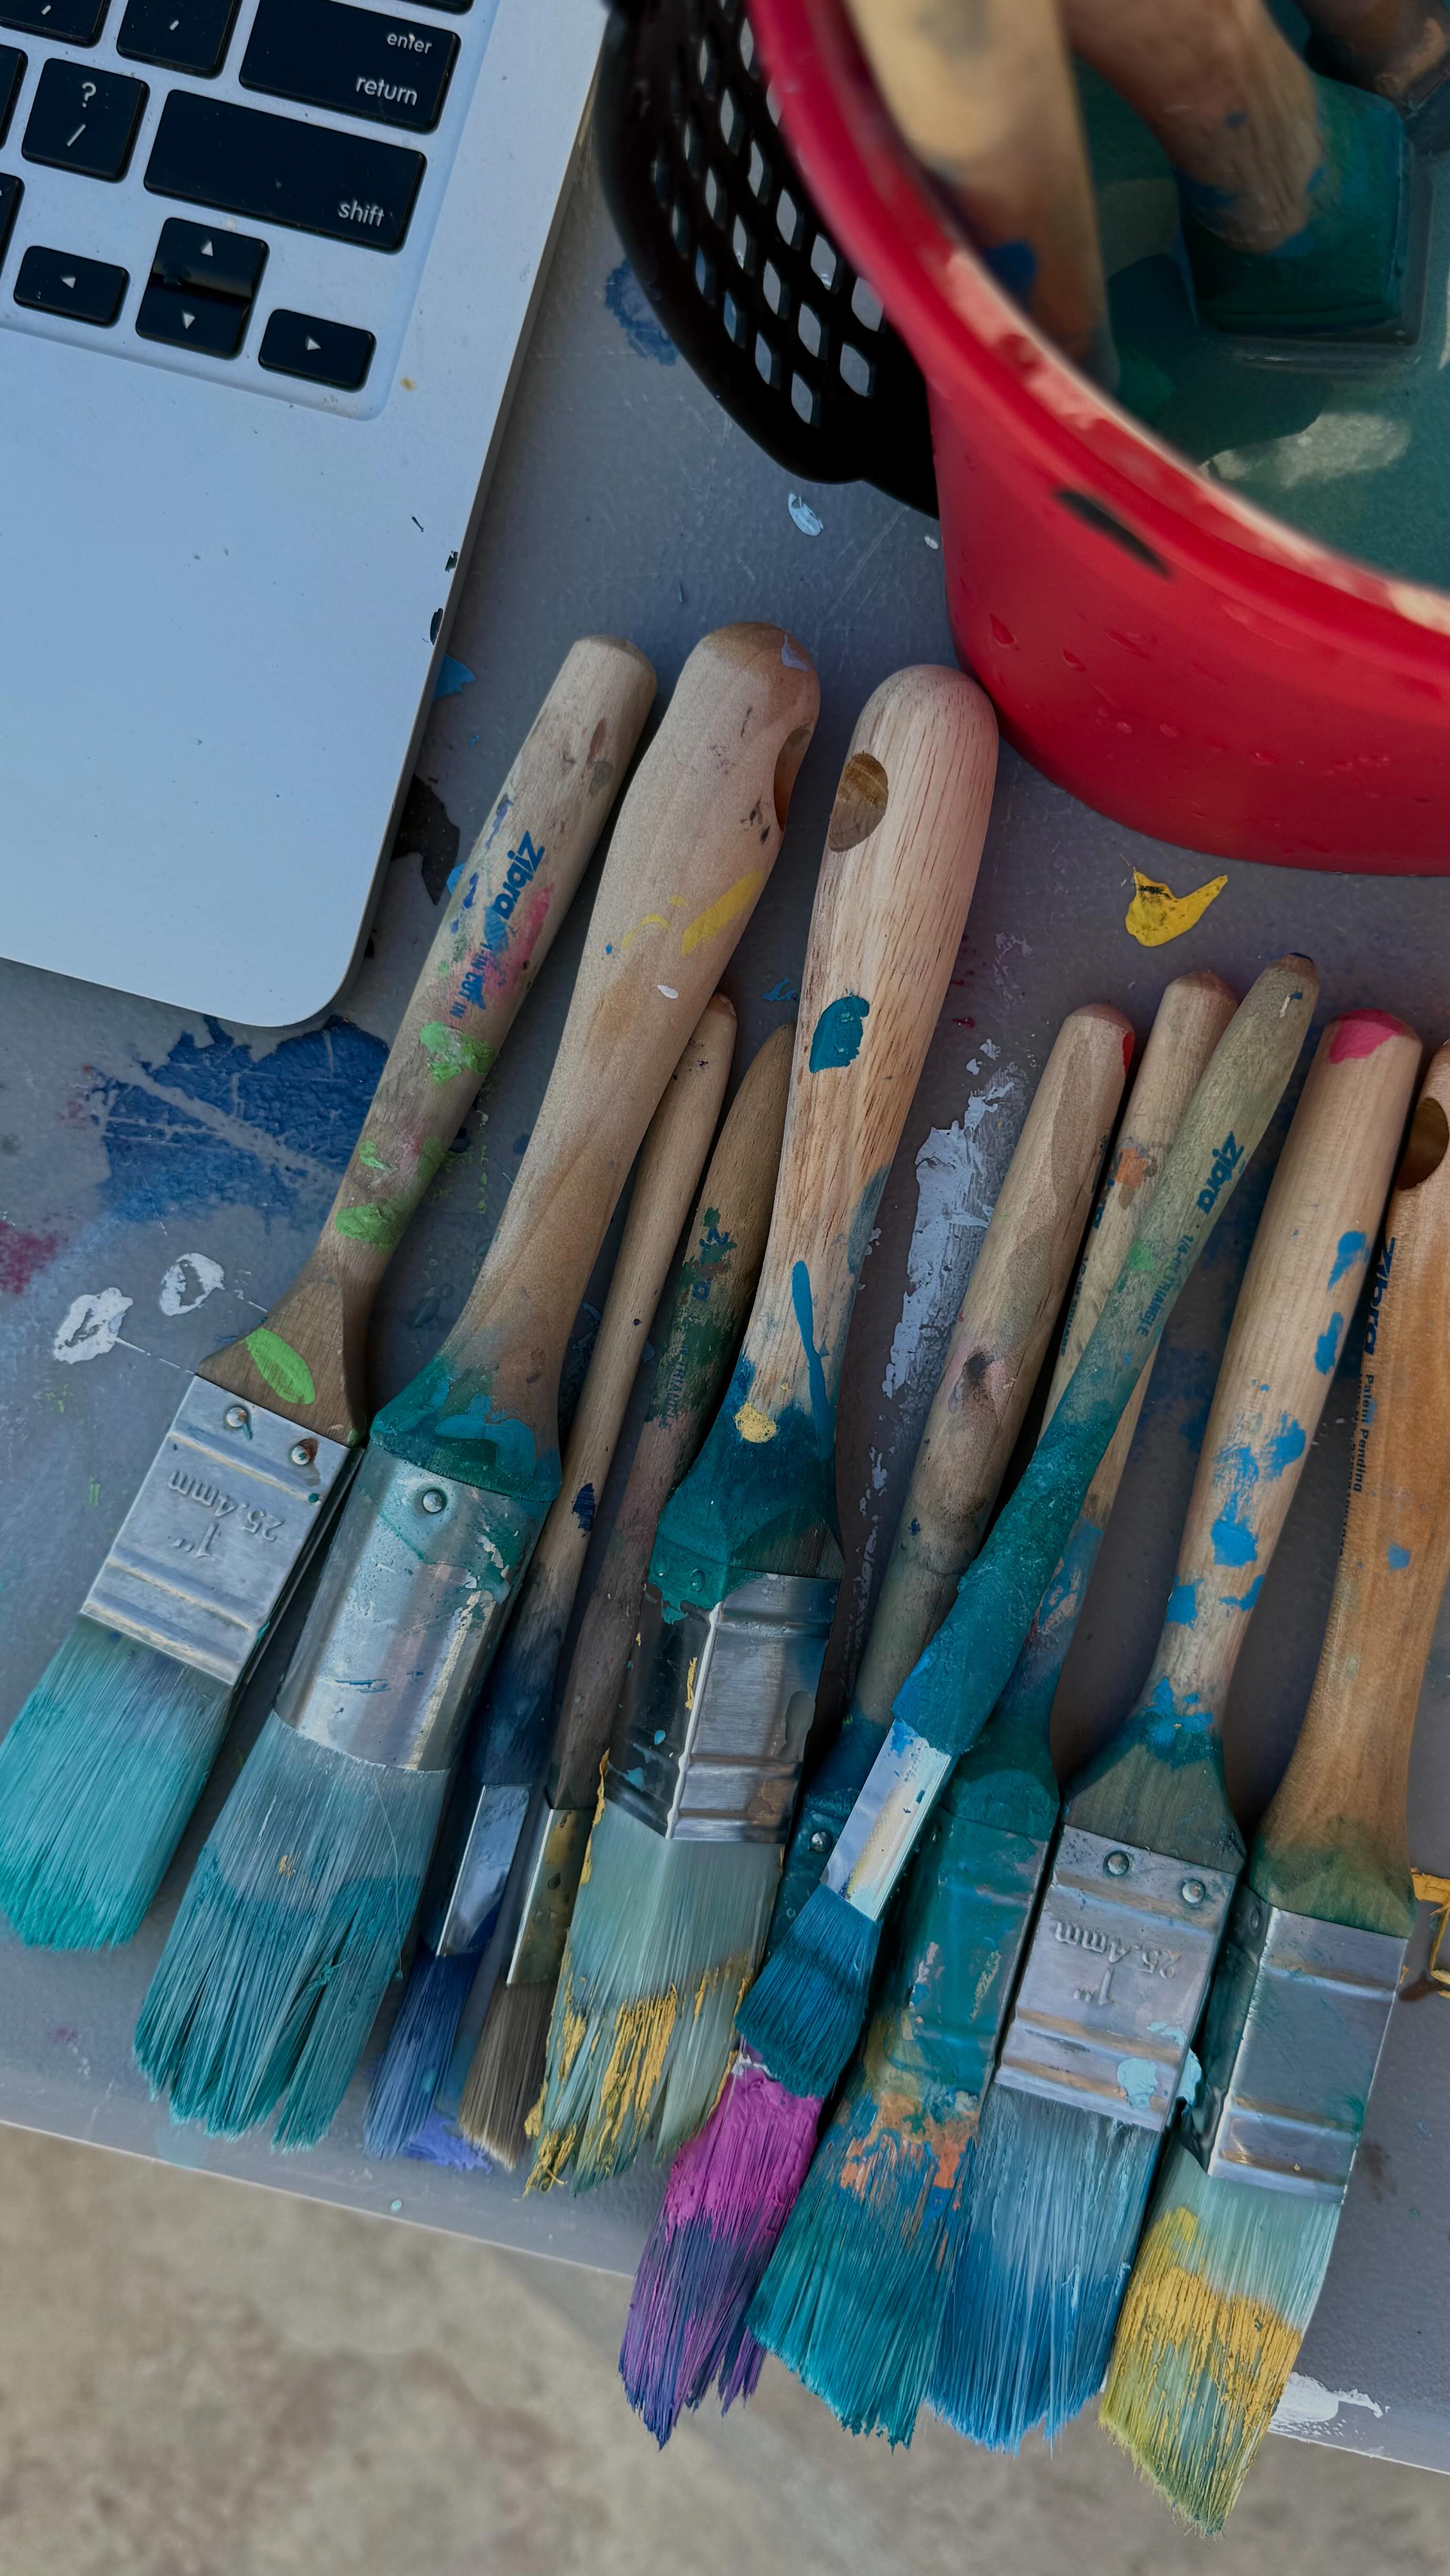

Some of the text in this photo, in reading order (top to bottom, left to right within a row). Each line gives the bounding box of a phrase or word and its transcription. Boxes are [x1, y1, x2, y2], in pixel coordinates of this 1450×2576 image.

[387, 33, 432, 54] enter
[82, 82, 96, 108] ?
[356, 76, 418, 106] return
[67, 124, 86, 146] /
[338, 198, 384, 227] shift
[491, 830, 545, 919] Zibra
[458, 971, 482, 1001] CUT
[450, 1000, 467, 1019] IN
[1196, 1130, 1244, 1214] Zibra
[1136, 1272, 1177, 1337] TRIANGLE
[1353, 1428, 1369, 1492] Pending
[168, 1471, 286, 1542] 25.4mm
[1055, 1921, 1181, 1979] 25.4mm
